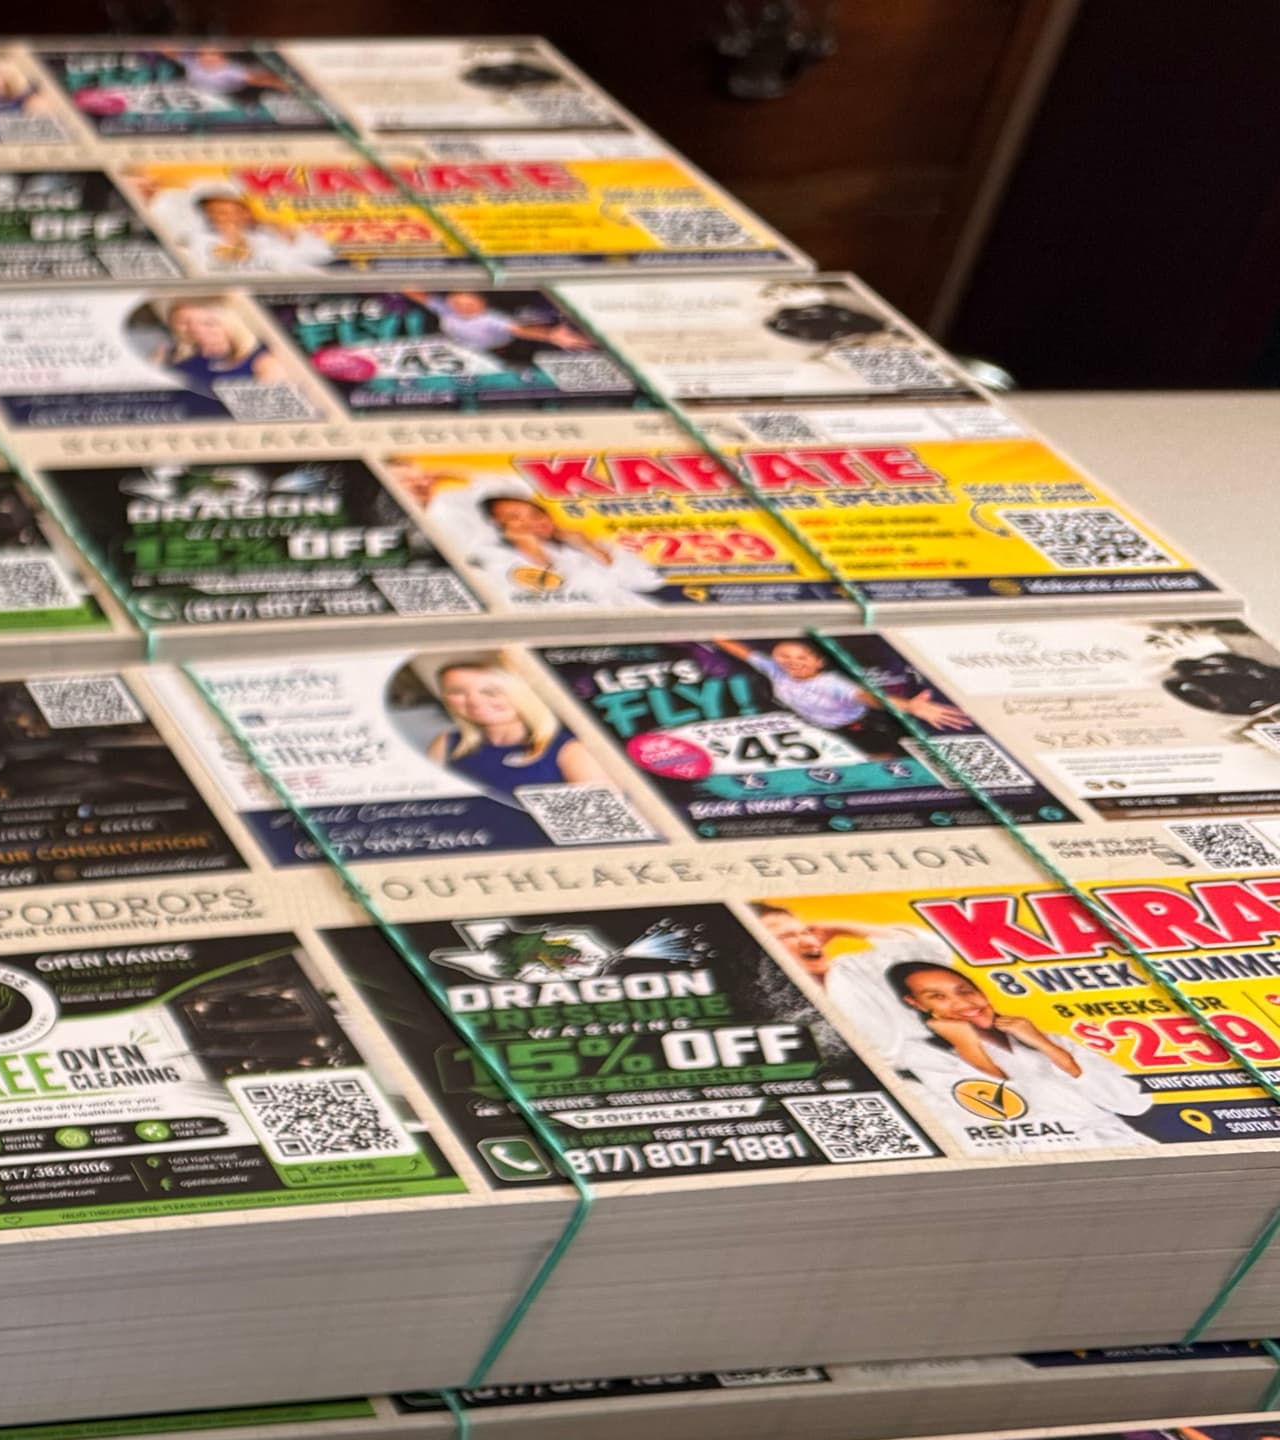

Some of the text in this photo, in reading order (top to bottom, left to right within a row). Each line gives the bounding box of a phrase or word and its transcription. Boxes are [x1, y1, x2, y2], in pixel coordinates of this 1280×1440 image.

[513, 444, 946, 501] KARATE
[287, 527, 403, 560] OFF
[755, 843, 993, 879] EDITION
[447, 971, 714, 1015] DRAGON
[990, 962, 1147, 995] 8 WEEK
[56, 1045, 148, 1071] OVEN
[662, 1023, 805, 1070] OFF
[68, 1065, 182, 1091] CLEANING
[967, 1120, 1077, 1142] REVEAL
